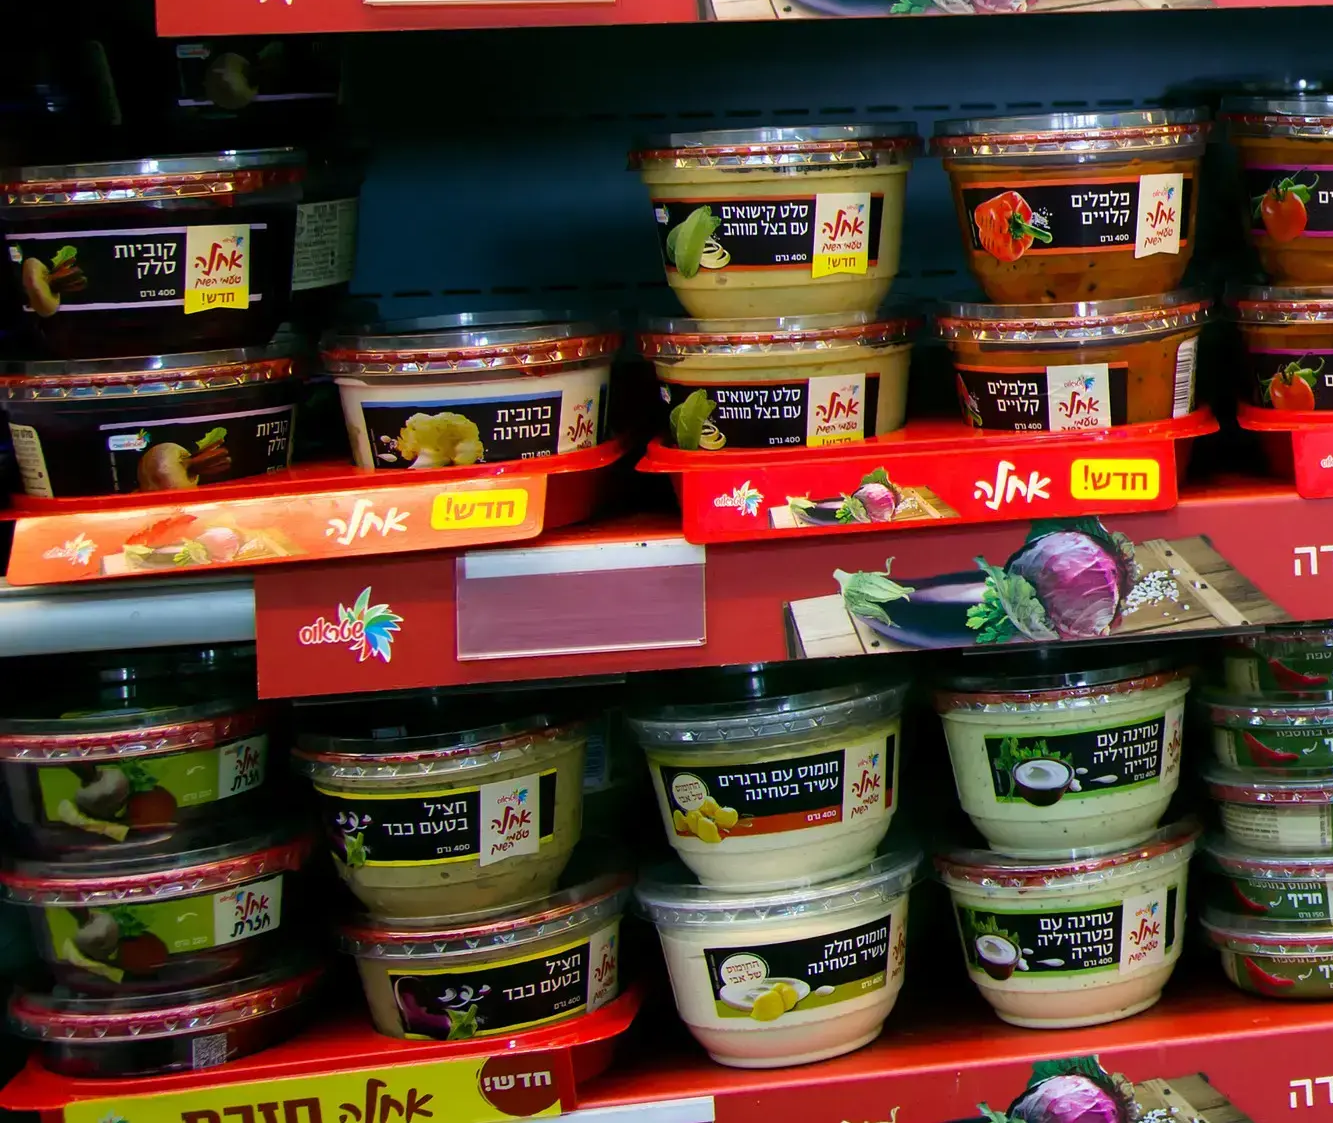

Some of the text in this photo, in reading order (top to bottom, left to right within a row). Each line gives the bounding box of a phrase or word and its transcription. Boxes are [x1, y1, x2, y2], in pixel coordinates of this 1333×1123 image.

[1071, 191, 1130, 210] פלפלים
[1081, 209, 1130, 226] קלויים
[114, 243, 177, 260] קוביות
[194, 242, 243, 275] אחלה
[137, 260, 177, 280] סלק
[445, 496, 515, 522] חדש!
[423, 801, 468, 818] חציל
[382, 818, 469, 835] בטעם כבד
[1038, 930, 1113, 946] פטרוזיליה
